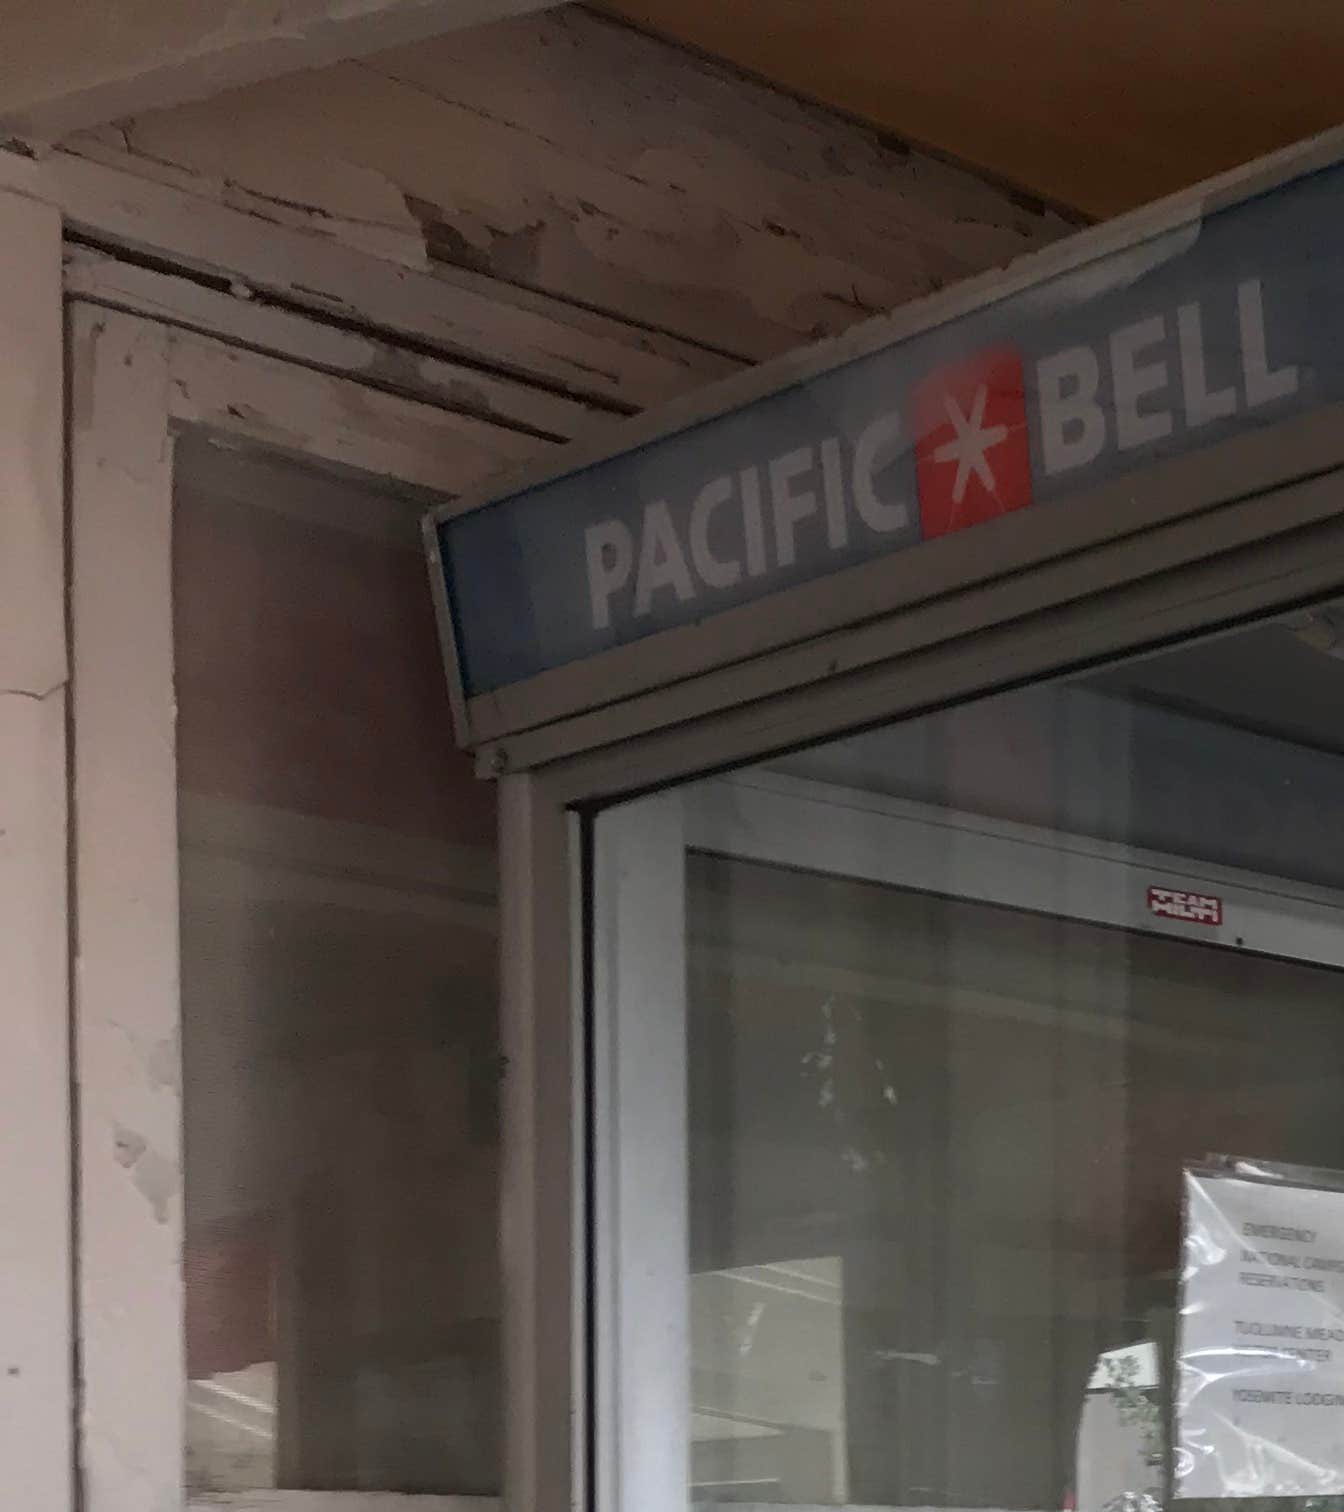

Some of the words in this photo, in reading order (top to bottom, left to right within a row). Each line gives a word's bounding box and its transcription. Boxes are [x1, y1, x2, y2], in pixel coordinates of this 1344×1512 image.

[585, 410, 911, 630] PACIFIC
[1034, 278, 1300, 481] BELL
[1243, 1222, 1317, 1243] EMERGENCY
